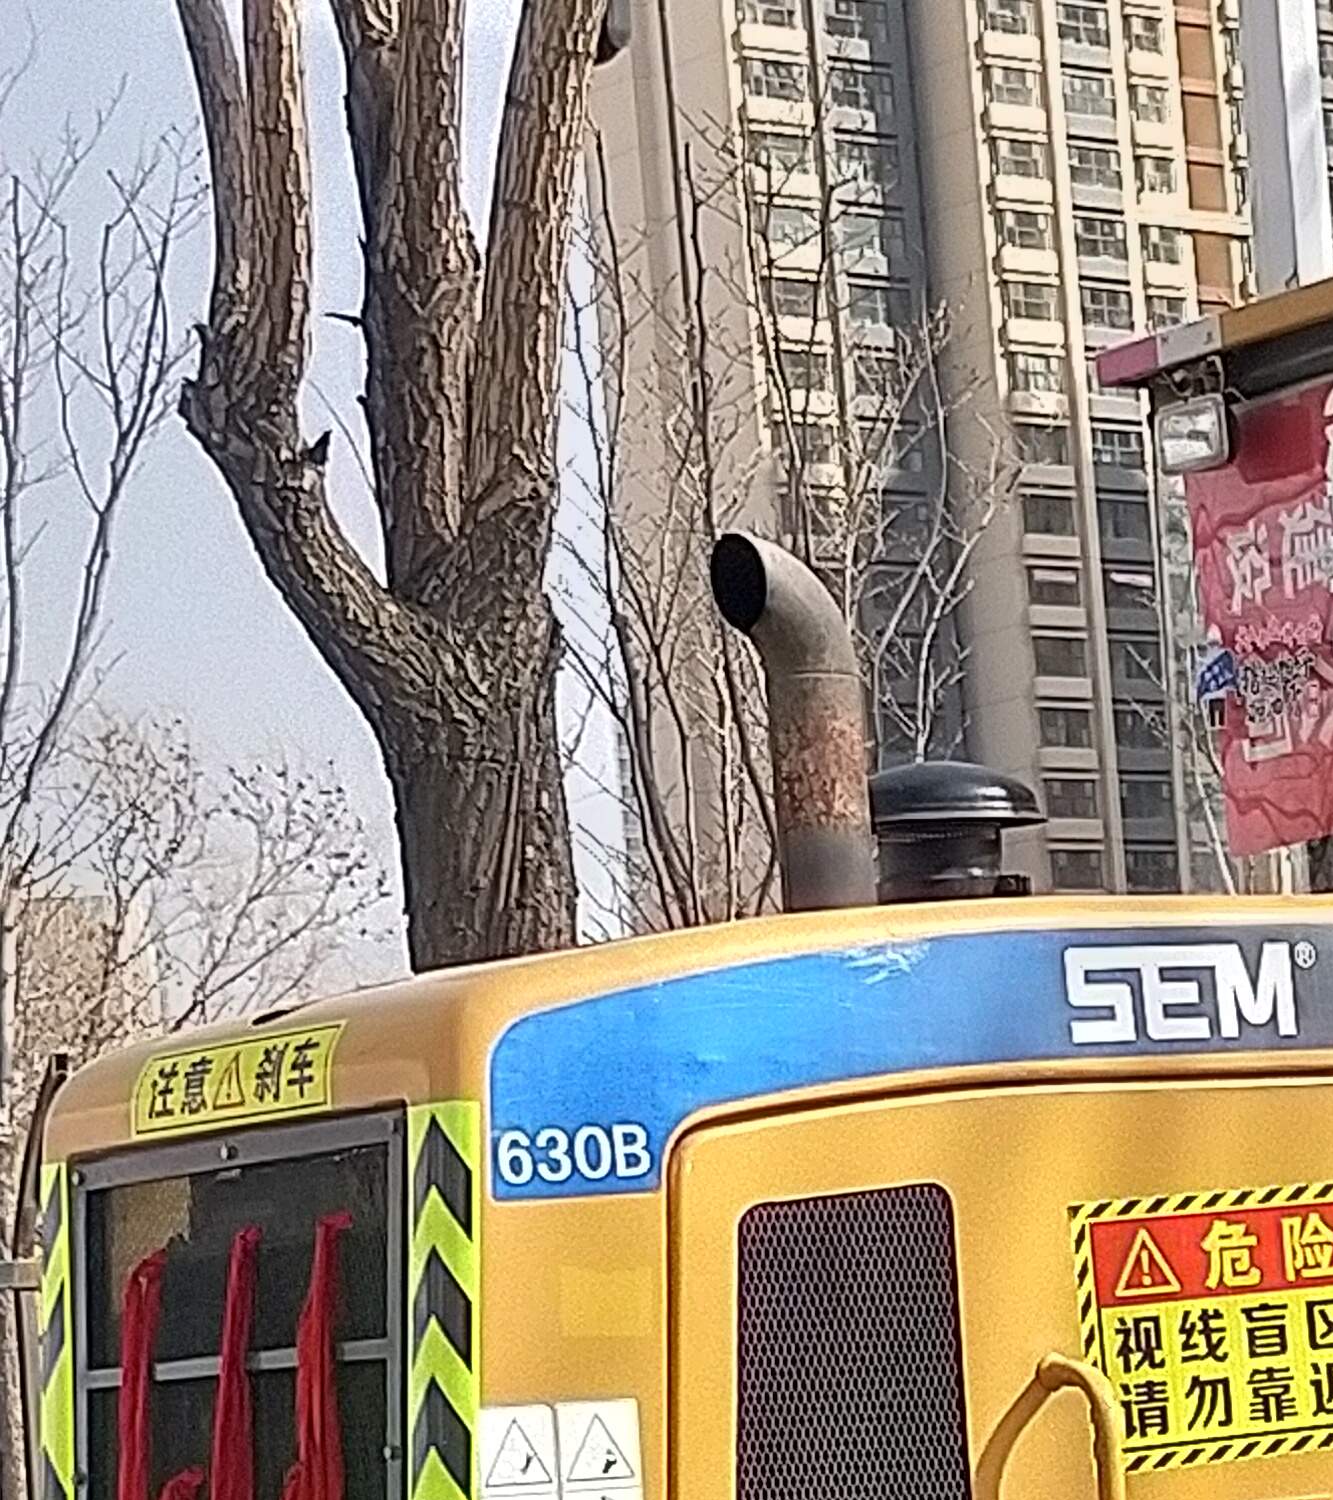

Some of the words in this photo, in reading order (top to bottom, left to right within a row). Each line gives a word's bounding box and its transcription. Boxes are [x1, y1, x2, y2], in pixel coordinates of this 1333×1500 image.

[147, 1057, 213, 1120] 注意
[252, 1038, 321, 1104] 刹车
[496, 1124, 653, 1186] 630B
